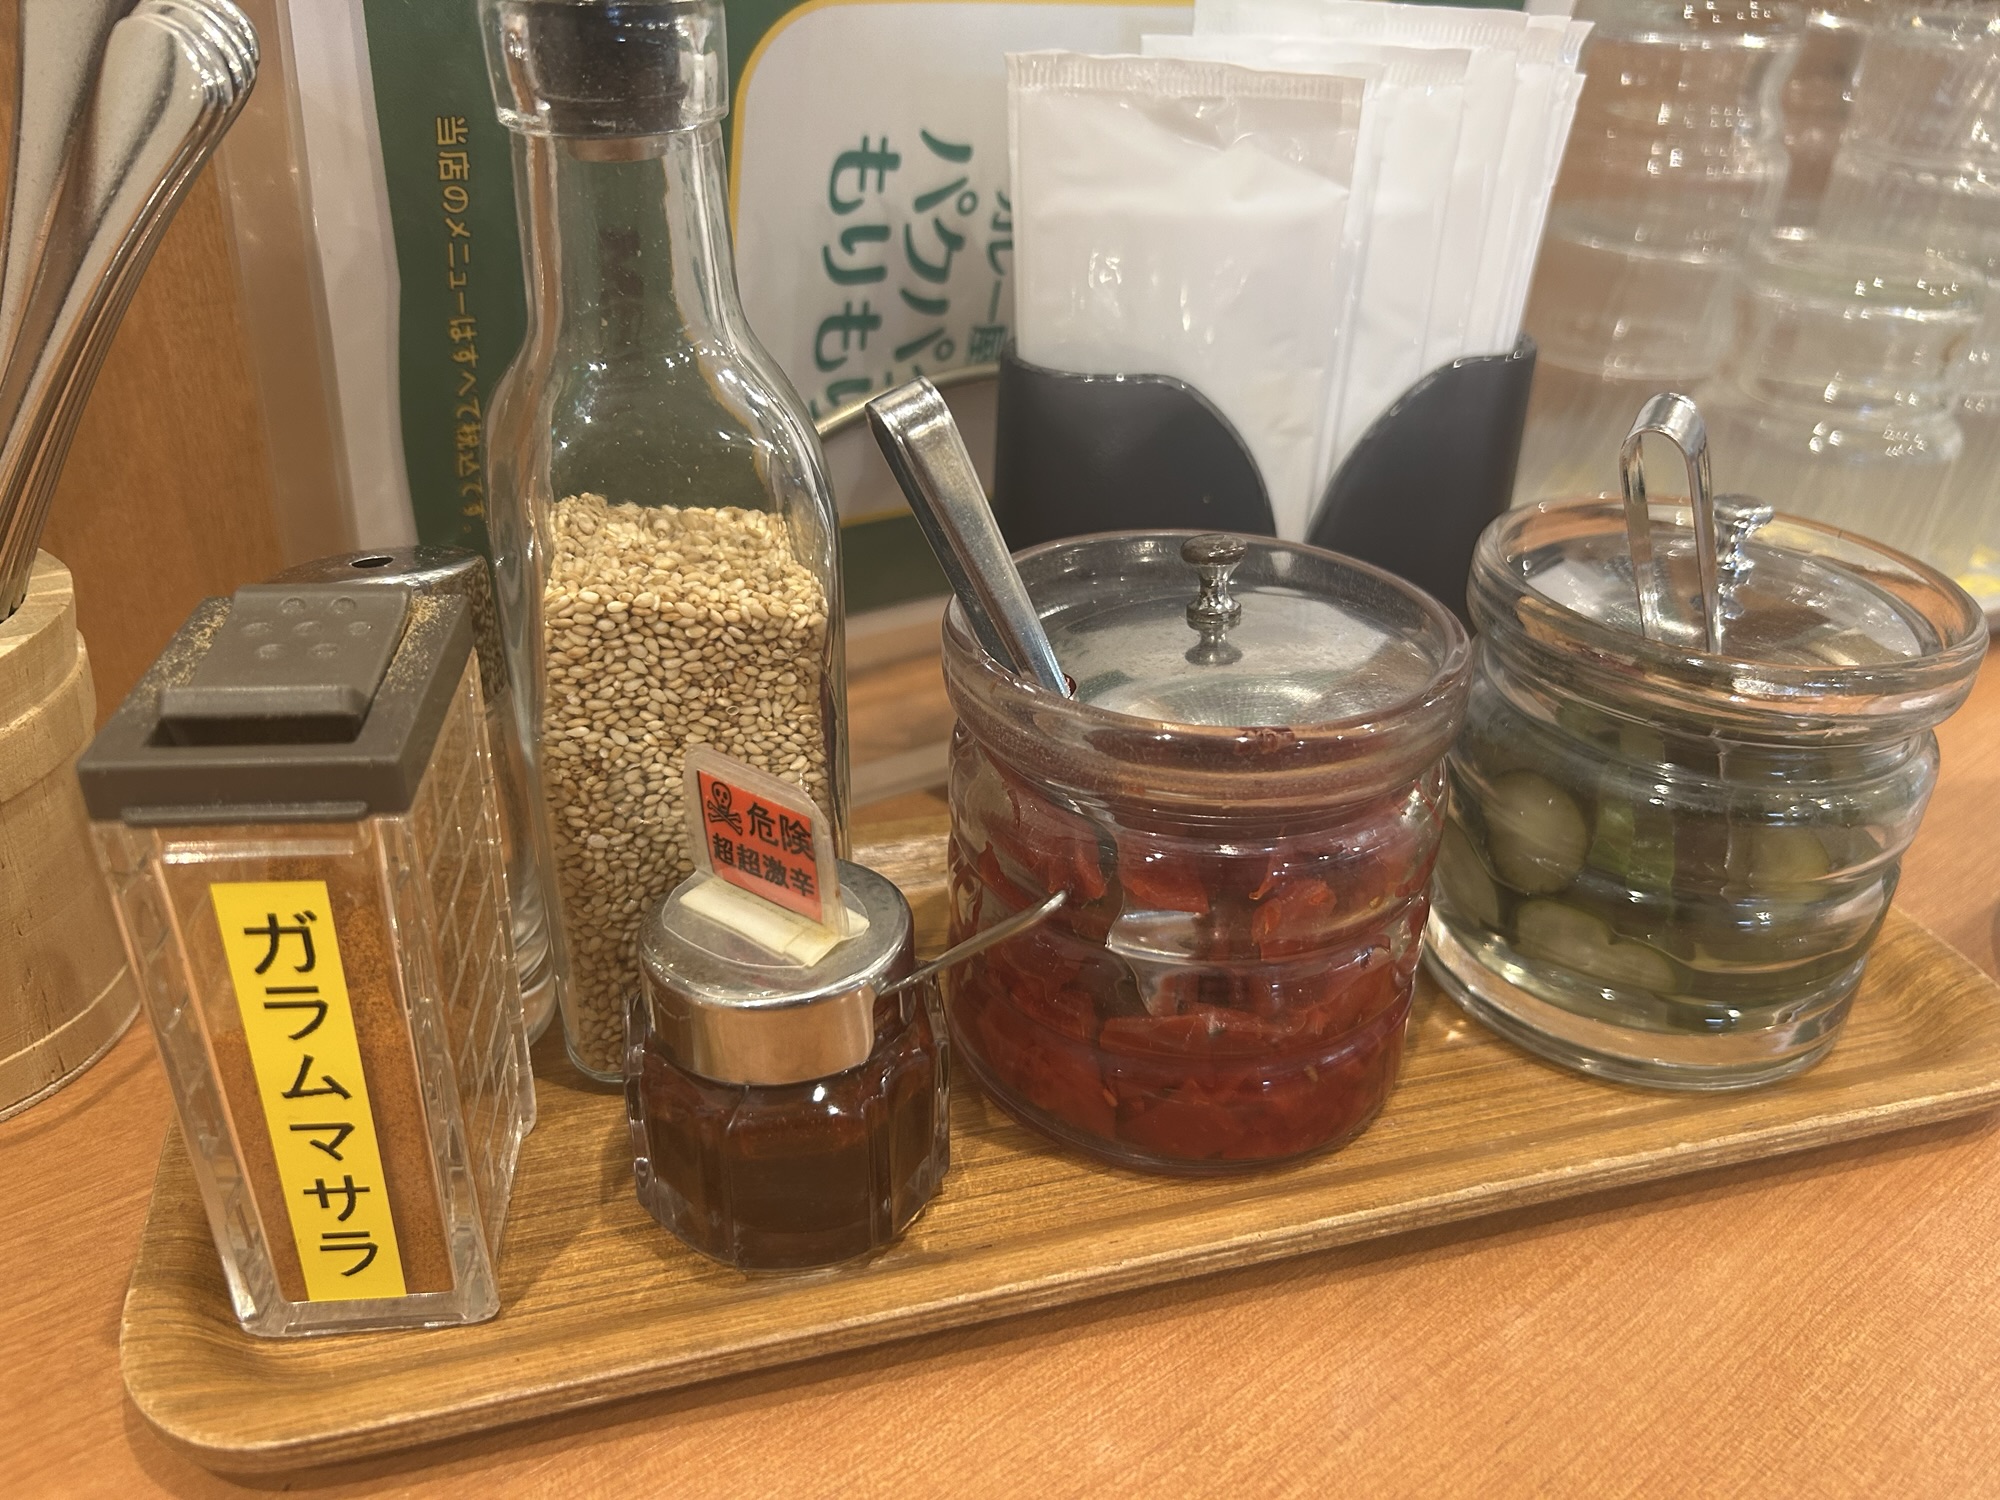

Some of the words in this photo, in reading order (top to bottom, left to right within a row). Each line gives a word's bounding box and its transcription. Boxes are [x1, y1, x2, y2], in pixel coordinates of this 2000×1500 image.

[884, 128, 979, 386] パクパ
[712, 832, 815, 897] 超超激辛
[746, 801, 816, 863] 危険
[243, 909, 379, 1277] ガラムマサラ
